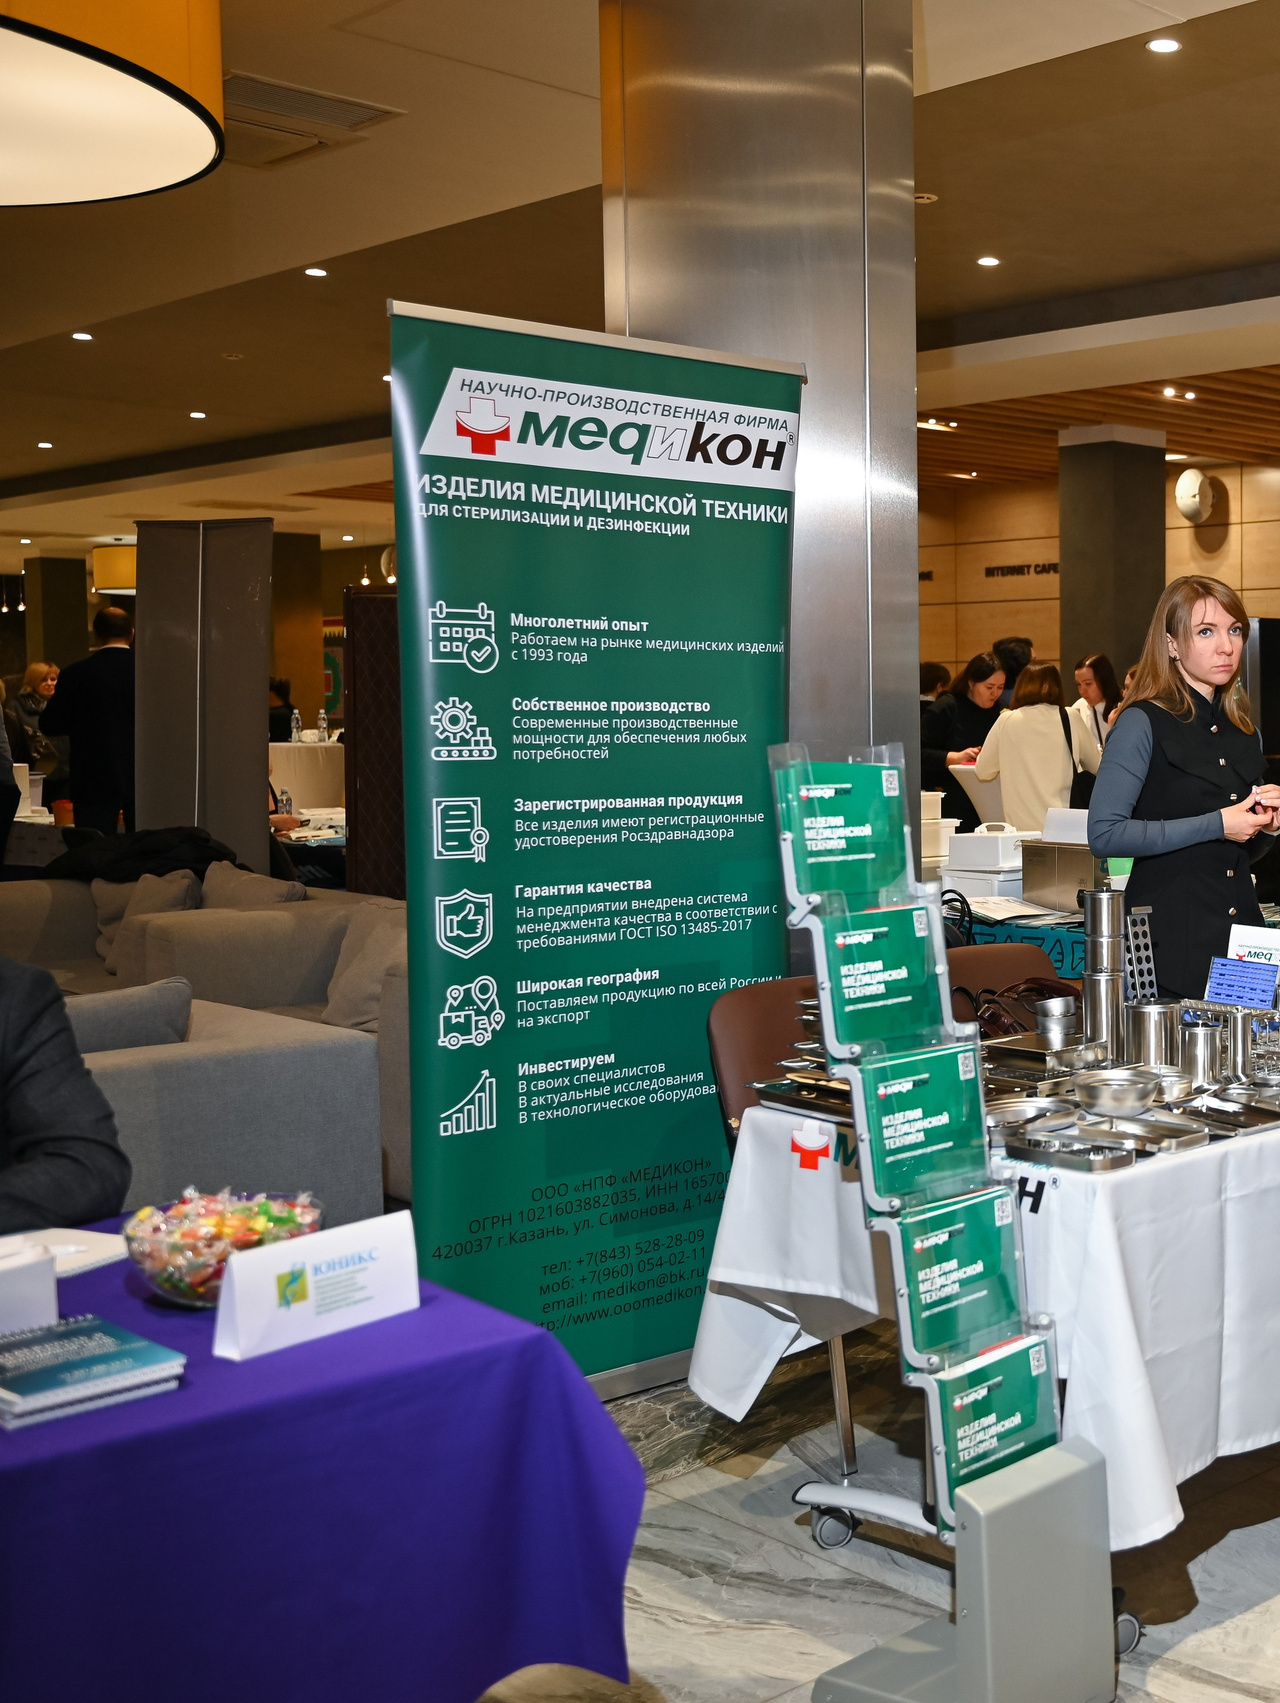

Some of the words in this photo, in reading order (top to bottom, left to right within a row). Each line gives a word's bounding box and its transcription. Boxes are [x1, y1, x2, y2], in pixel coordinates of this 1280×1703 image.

[460, 378, 730, 422] НАУЧНО-ПРОИЗВОДСТВЕННАЯ
[733, 411, 790, 432] ФИРМА
[416, 474, 526, 501] ИЗДЕЛИЯ
[531, 484, 697, 516] МЕДИЦИНСКОЙ
[702, 500, 788, 524] ТЕХНИКИ
[415, 502, 449, 518] ДЛЯ
[452, 505, 570, 528] СТЕРИЛИЗАЦИИ
[574, 515, 584, 527] И
[586, 516, 690, 536] ДЕЗИНФЕКЦИИ
[984, 564, 1031, 578] INTERNET
[510, 613, 608, 630] Многолетний
[612, 618, 649, 632] опыт
[511, 632, 578, 647] Работаем
[581, 636, 598, 647] на
[600, 638, 643, 651] рынке
[646, 638, 734, 653] медицинских
[737, 642, 784, 654] изделий
[522, 647, 554, 662] 1993
[557, 651, 588, 664] года
[512, 698, 608, 712] Собственное
[610, 700, 711, 715] производство
[512, 716, 610, 732] Современные
[612, 717, 738, 732] производственные
[512, 732, 584, 747] мощности
[587, 732, 610, 746] для
[614, 731, 700, 746] обеспечения
[703, 730, 748, 743] любых
[512, 746, 610, 762] потребностей
[514, 794, 665, 813] Зарегистрированная
[668, 792, 744, 809] продукция
[516, 818, 540, 832] Все
[542, 818, 598, 832] изделия
[602, 816, 646, 829] имеют
[648, 810, 765, 828] регистрационные
[515, 831, 618, 850] удостоверения
[621, 826, 735, 844] Росздравнадзора
[516, 883, 584, 898] Гарантия
[587, 878, 652, 894] качества
[516, 906, 534, 918] На
[538, 900, 628, 919] предприятии
[631, 896, 694, 914] внедрена
[696, 893, 748, 906] система
[516, 916, 611, 935] менеджмента
[614, 912, 673, 927] качества
[676, 912, 682, 922] в
[686, 906, 770, 921] соответствии
[516, 930, 616, 951] требованиями
[620, 926, 652, 940] ГОСТ
[656, 922, 678, 936] ISO
[681, 918, 752, 935] 13485-2017
[516, 976, 584, 994] Широкая
[587, 968, 661, 990] география
[517, 995, 598, 1013] Поставляем
[602, 986, 676, 1005] продукцию
[678, 982, 694, 994] по
[698, 978, 727, 992] всей
[517, 1016, 534, 1028] на
[537, 1010, 590, 1027] экспорт
[518, 1052, 616, 1076] Инвестируем
[518, 1080, 527, 1092] В
[530, 1074, 570, 1090] своих
[574, 1062, 666, 1085] специалистов
[518, 1096, 528, 1108] В
[530, 1086, 611, 1108] актуальные
[614, 1072, 704, 1094] исследования
[518, 1112, 528, 1124] В
[530, 1095, 646, 1122] технологическое
[649, 1084, 719, 1103] оборудова
[532, 1183, 569, 1202] ООО
[573, 1174, 617, 1194] «НПФ
[622, 1158, 712, 1184] «МЕДИКОН»
[469, 1213, 512, 1234] ОГРН
[518, 1188, 641, 1224] 1021603882035,
[646, 1181, 678, 1199] ИНН
[432, 1236, 493, 1260] 420037
[574, 1218, 594, 1236] ул.
[600, 1202, 679, 1226] Симонова,
[541, 1260, 572, 1276] тел:
[576, 1245, 631, 1267] +7(843)
[636, 1228, 704, 1256] 528-28-09
[540, 1276, 574, 1296] моб:
[580, 1262, 634, 1284] +7(960)
[638, 1246, 705, 1273] 054-02-11
[542, 1292, 588, 1314] email:
[592, 1266, 704, 1302] medikon@bk.ru
